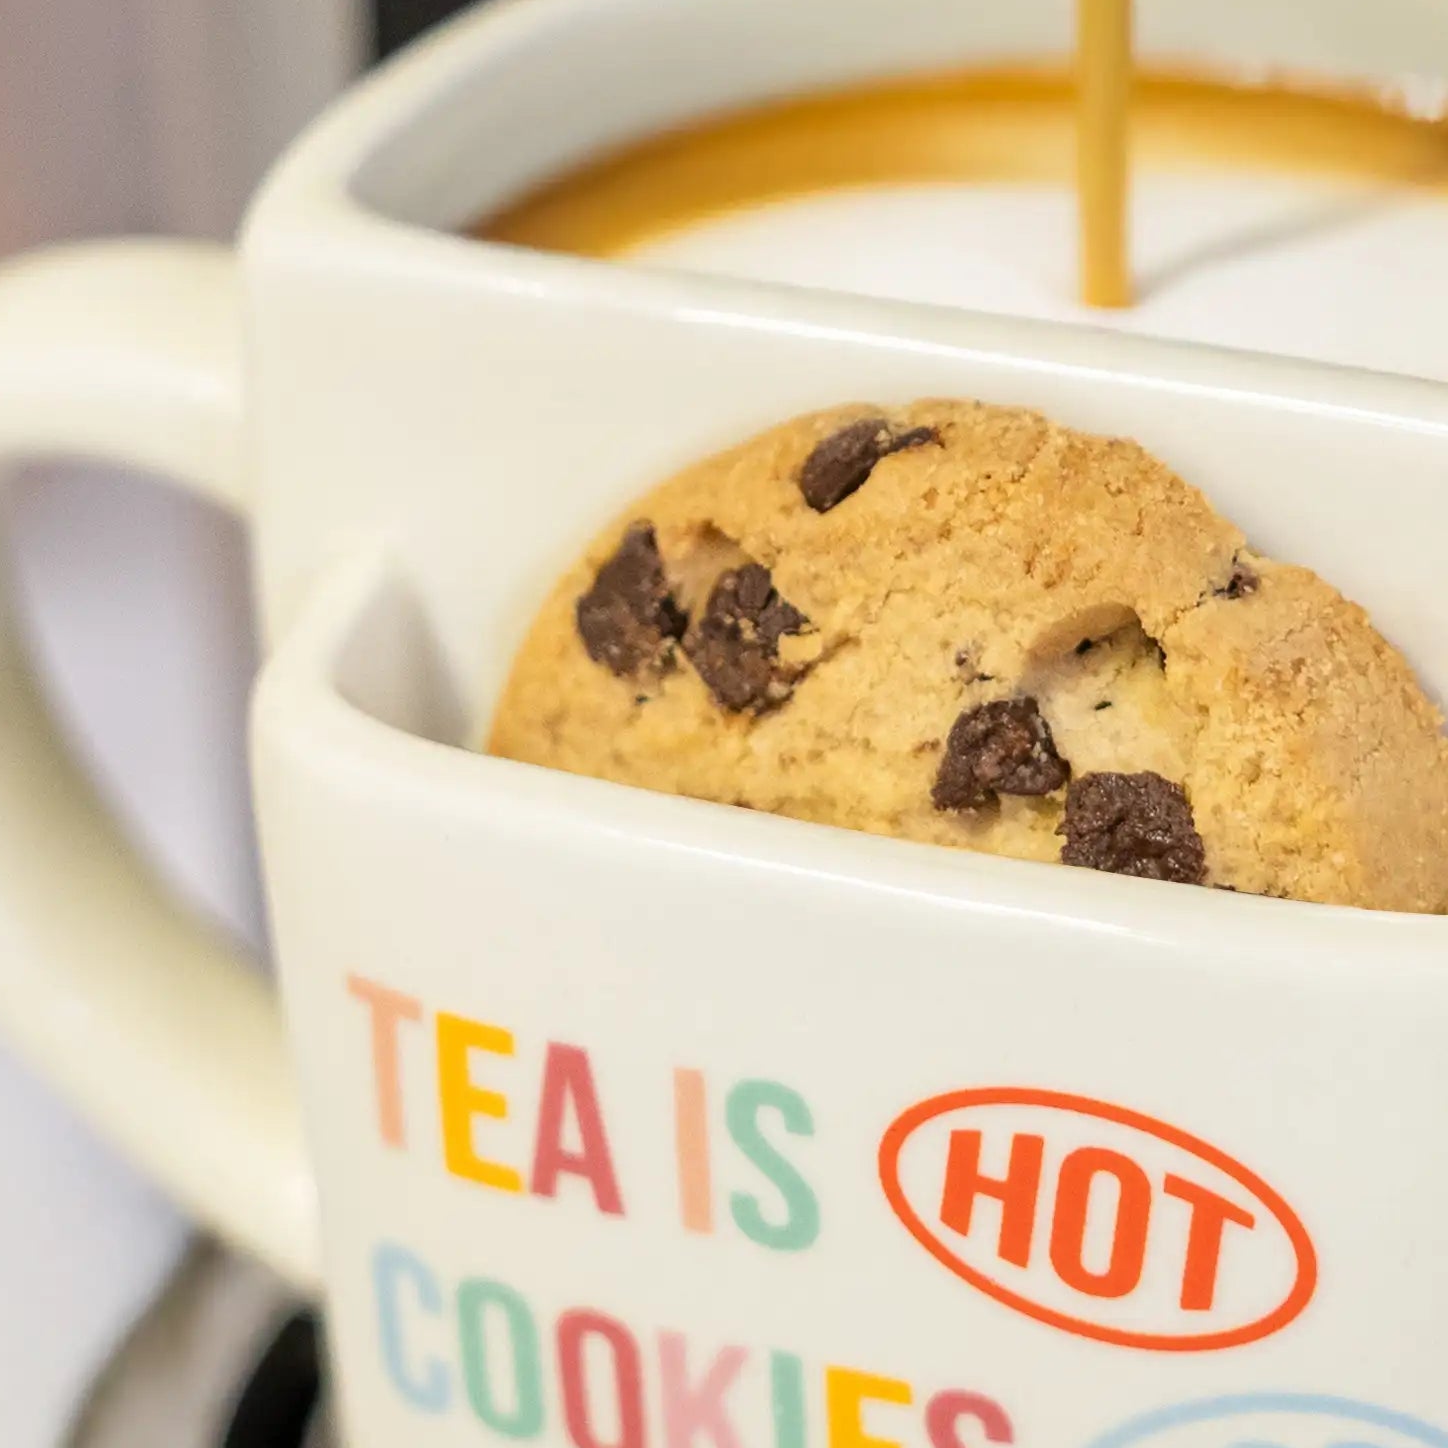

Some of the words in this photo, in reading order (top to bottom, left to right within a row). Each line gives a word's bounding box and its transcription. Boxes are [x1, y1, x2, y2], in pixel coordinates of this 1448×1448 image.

[348, 973, 625, 1216] TEA
[674, 1067, 821, 1251] IS
[940, 1130, 1256, 1311] HOT
